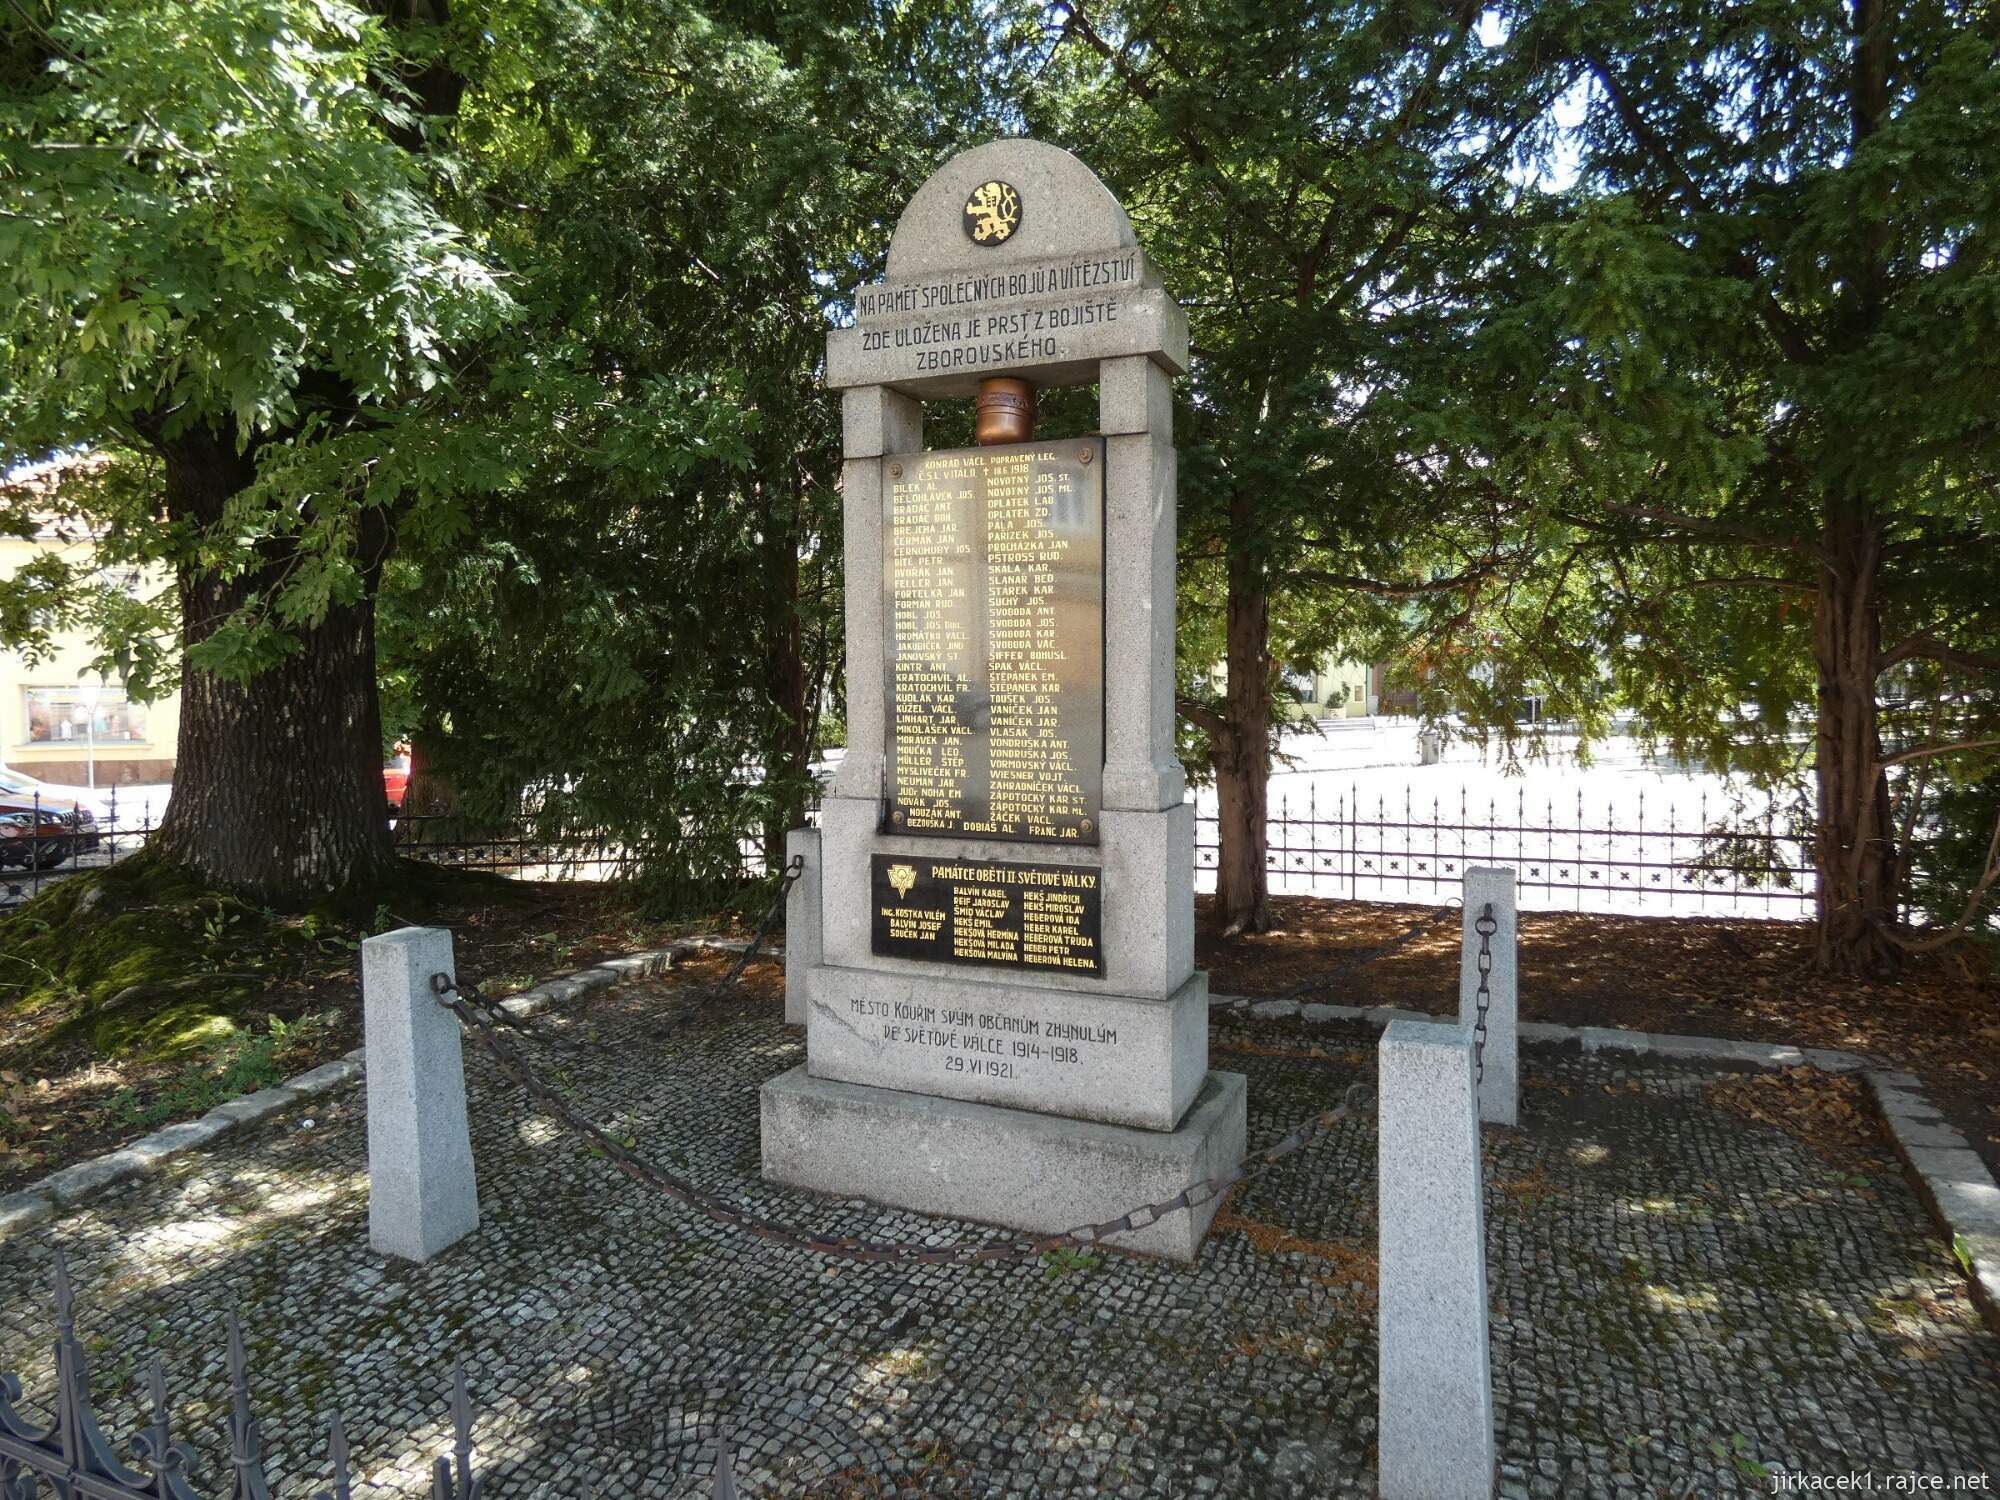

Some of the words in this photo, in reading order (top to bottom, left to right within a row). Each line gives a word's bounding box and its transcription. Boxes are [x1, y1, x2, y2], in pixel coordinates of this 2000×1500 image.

[860, 295, 875, 317] NA
[878, 284, 920, 314] PAMĚŤ
[921, 274, 1005, 308] SPOLEČNÝCH
[1048, 269, 1057, 292] A
[1061, 252, 1136, 289] VÍTĚZSTVÍ
[862, 330, 890, 351] ZDE
[895, 320, 961, 347] ULOŽENA
[965, 319, 981, 339] JE
[988, 308, 1031, 335] PRSŤ
[1035, 311, 1044, 330] Z
[1049, 297, 1117, 329] BOJIŠTĚ
[896, 663, 922, 672] KINTR
[896, 672, 953, 682] KRATOCHVÍL
[896, 715, 934, 724] LINHART
[896, 723, 948, 734] MIKOLÁŠEK
[990, 759, 1046, 770] VORMOVSKÝ
[897, 766, 951, 777] MYSLIVEČEK
[990, 770, 1034, 780] WIESNER
[897, 777, 933, 786] NEUMAN
[990, 780, 1054, 792] ZAHRADNÍČEK
[897, 796, 925, 807] NOVÁK
[990, 790, 1045, 803] ZÁPOTOCKÝ
[990, 801, 1045, 813] ZÁPOTOCKÝ
[963, 821, 997, 832] DOBIÁŠ
[932, 863, 975, 881] PAMÁTCE
[976, 866, 1005, 883] OBĚTÍ
[1018, 869, 1060, 887] SVĚTOVÉ
[953, 885, 980, 897] BALVÍN
[982, 889, 1007, 898] KAREL
[1023, 889, 1044, 902] HEKŠ
[953, 896, 971, 906] REIF
[972, 898, 1010, 909] JAROSLAV
[1023, 901, 1044, 912] HEKŠ
[1045, 903, 1085, 915] MIROSLAV
[896, 908, 923, 919] KOSTKA
[924, 909, 946, 921] VILÉM
[975, 907, 1005, 919] VÁCLAV
[918, 921, 942, 931] JOSEF
[974, 919, 993, 929] EMIL
[1066, 916, 1080, 926] IDA
[890, 927, 918, 939] SOUČEK
[920, 931, 936, 941] JAN
[987, 928, 1019, 941] HERMÍNA
[1052, 926, 1079, 936] KAREL
[987, 940, 1015, 951] MILADA
[1064, 936, 1093, 947] TRUDA
[987, 950, 1018, 961] MALVÍNA
[1049, 945, 1070, 955] PETR
[942, 1007, 973, 1028] SVÝM
[979, 1013, 1039, 1035] OBČANŮM
[1046, 1022, 1117, 1045] ZHYNULÝM
[884, 1025, 899, 1041] VE
[904, 1025, 958, 1049] SVĚTOVÉ
[963, 1032, 1004, 1055] VÁLCE
